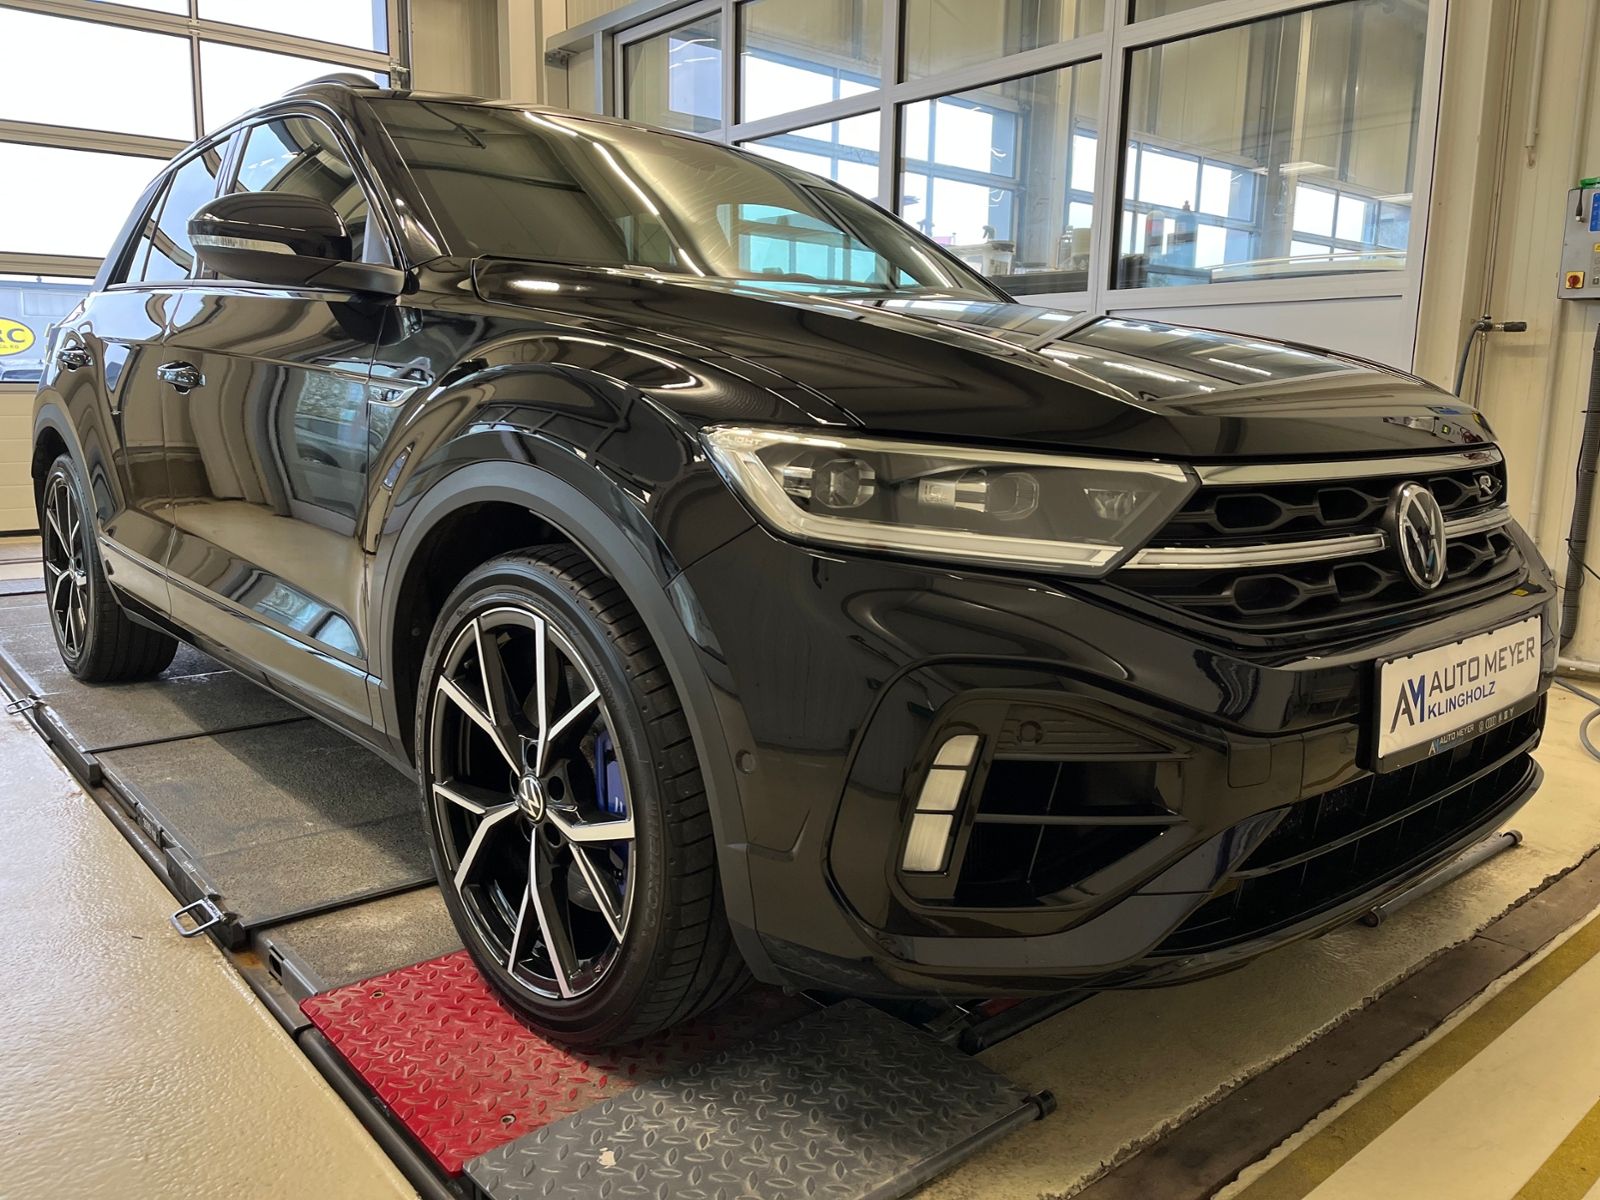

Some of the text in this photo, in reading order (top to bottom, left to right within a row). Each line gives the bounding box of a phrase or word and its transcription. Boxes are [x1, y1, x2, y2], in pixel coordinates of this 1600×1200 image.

[1428, 656, 1480, 697] AUTO
[1484, 636, 1535, 677] MEYER
[1427, 680, 1496, 719] KLINGHOLZ
[1440, 731, 1456, 745] AUTO
[1456, 723, 1475, 738] MEYER
